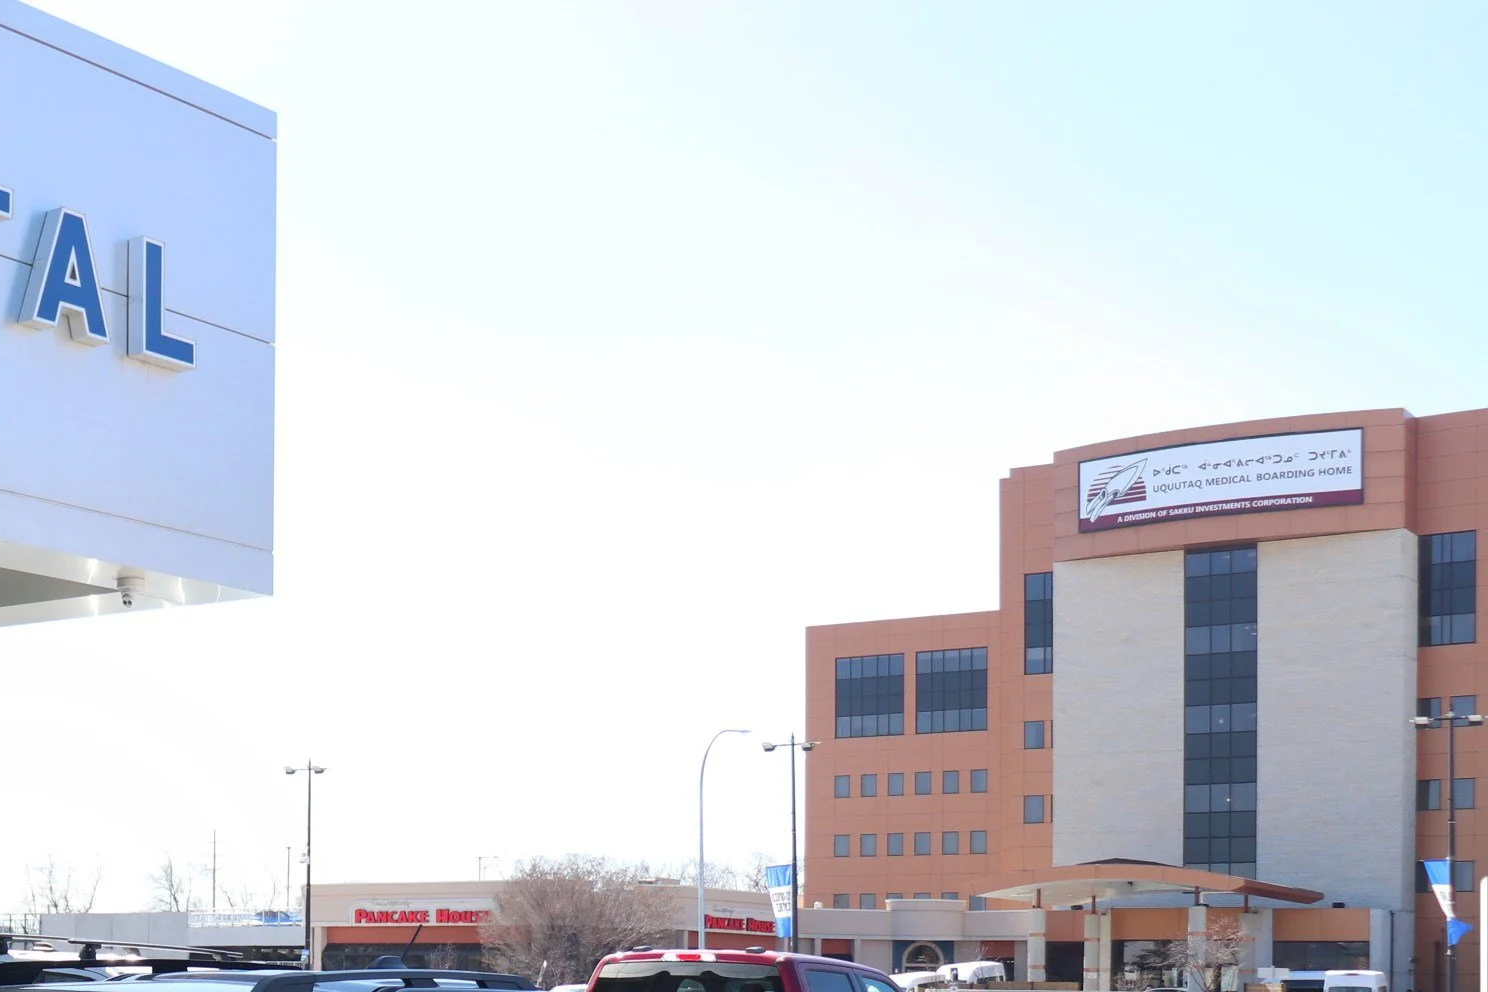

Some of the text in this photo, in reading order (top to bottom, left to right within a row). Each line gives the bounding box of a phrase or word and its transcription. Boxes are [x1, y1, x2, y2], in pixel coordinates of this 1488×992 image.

[1152, 466, 1352, 493] UQUUTAQ MEDICAL BOARDING HOME
[1124, 512, 1156, 522] DIVISION
[1157, 510, 1168, 518] OF
[1169, 506, 1194, 516] SAKKU
[1195, 501, 1251, 512] INVESTMENTS
[1252, 496, 1313, 507] CORPORATION
[355, 909, 430, 923] PANCAKE
